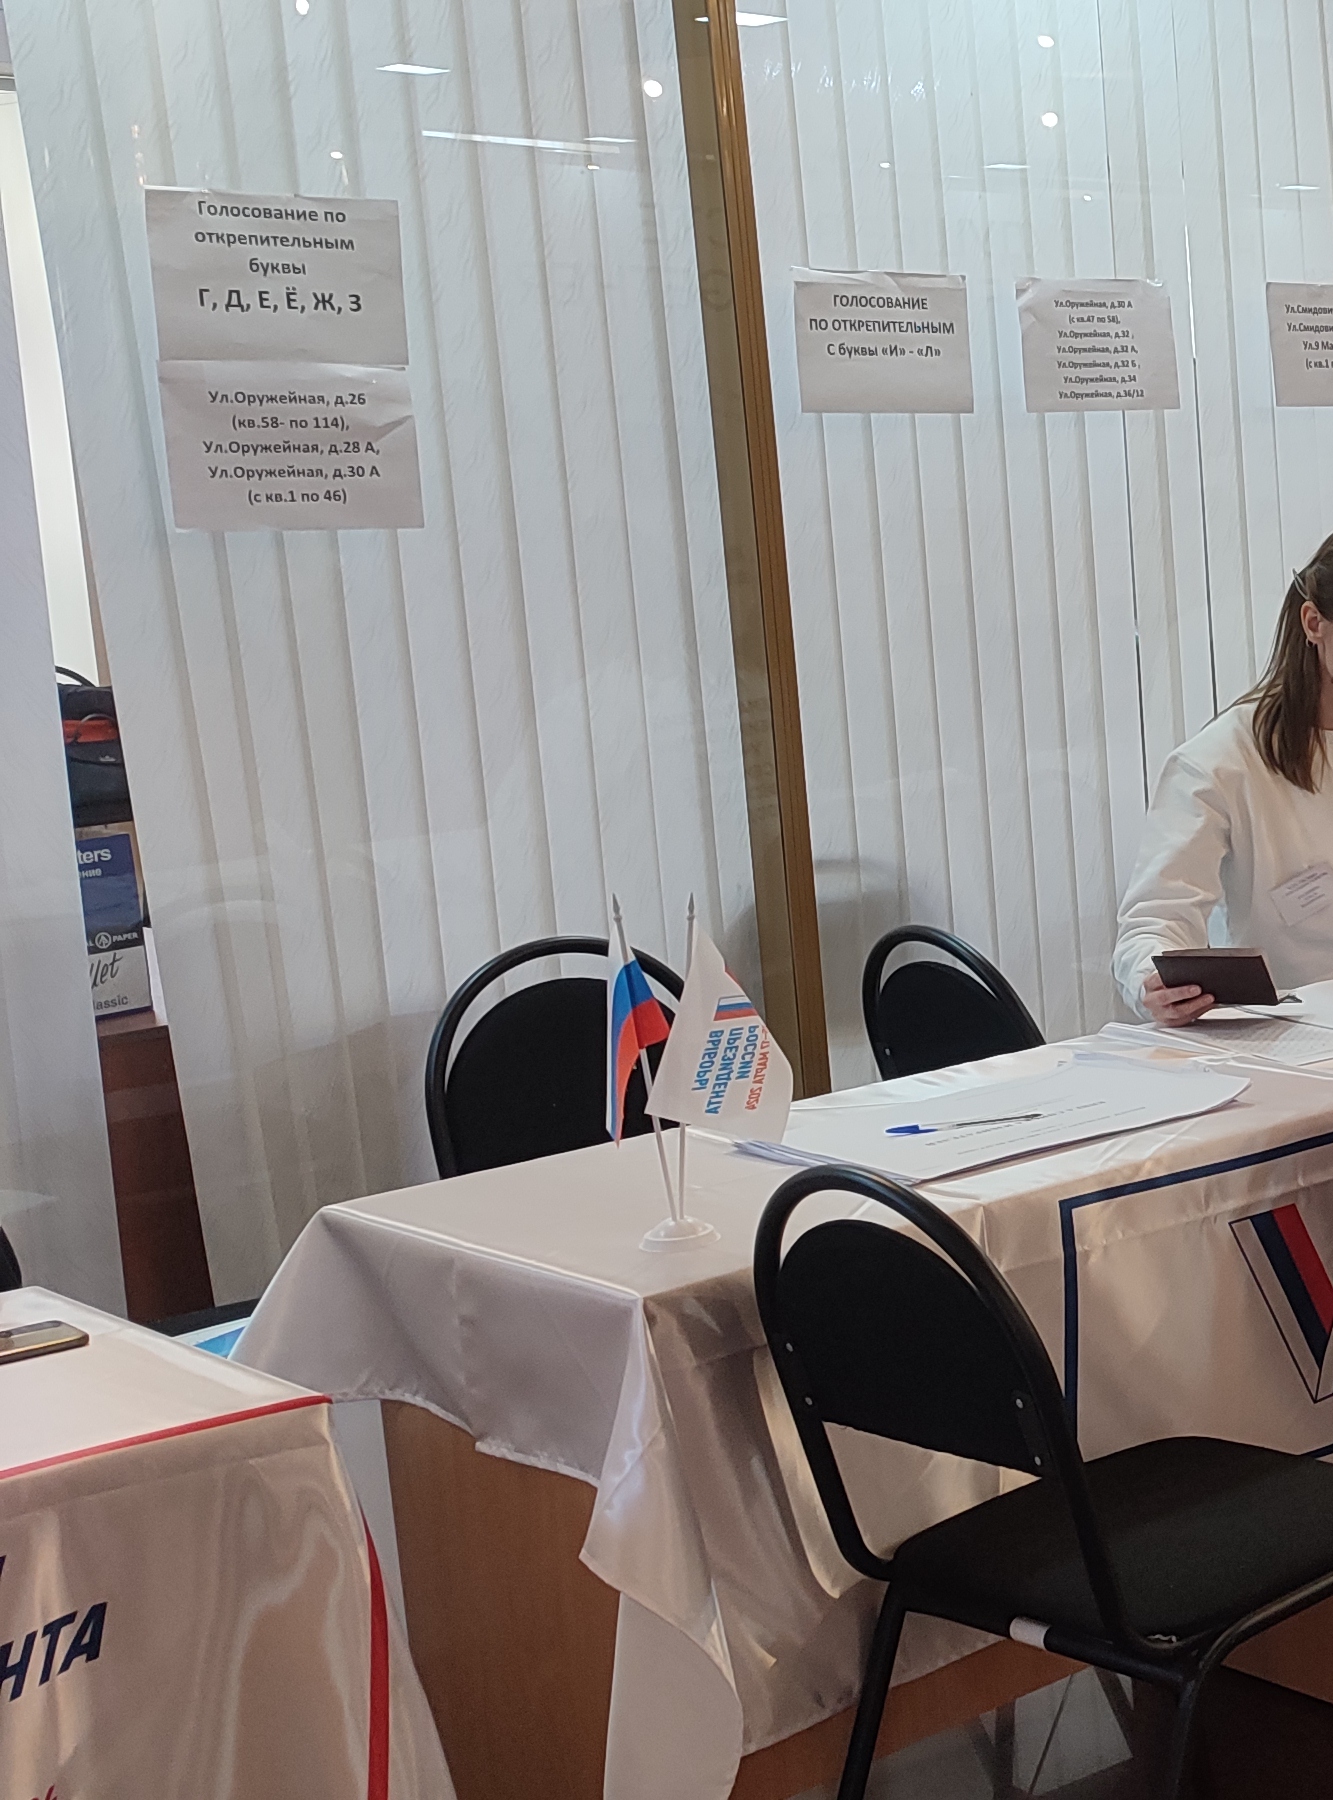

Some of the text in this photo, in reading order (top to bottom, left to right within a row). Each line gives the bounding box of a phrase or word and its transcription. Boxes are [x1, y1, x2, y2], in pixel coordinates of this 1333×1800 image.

[198, 201, 346, 222] Голосование по
[195, 232, 354, 250] открепительным
[249, 258, 306, 277] буквы
[199, 287, 361, 315] Г, Д, Е, Ё, Ж, З
[834, 295, 928, 309] ГОЛОСОВАНИЕ
[1054, 300, 1108, 309] Ул.Оружейная,
[810, 318, 954, 334] ПО ОТКРЕПИТЕЛЬНЫМ
[1058, 330, 1112, 339] Ул.Оружейная,
[1114, 330, 1129, 339] д.32
[827, 344, 835, 355] С
[839, 343, 878, 358] буквы
[882, 344, 905, 356] «И»
[917, 346, 940, 357] «Л»
[1057, 345, 1111, 354] Ул.Оружейная,
[1113, 345, 1128, 354] д.32
[1303, 341, 1319, 350] Ул.9
[1057, 360, 1112, 369] Ул.Оружейная,
[1114, 360, 1129, 369] д.32
[1306, 358, 1312, 369] (с
[1314, 359, 1329, 368] кв.1
[1063, 375, 1136, 385] Ул.Оружейная, д.34
[208, 391, 366, 407] Ул.Оружейная, д.26
[1059, 390, 1114, 400] Ул.Оружейная,
[232, 415, 349, 431] (кв.58- по 114),
[203, 440, 379, 456] Ул.Оружейная, д.28 А,
[208, 465, 380, 480] Ул.Оружейная, д.30 А
[248, 489, 346, 505] (с кв.1 по 46)
[112, 932, 138, 942] PAPER
